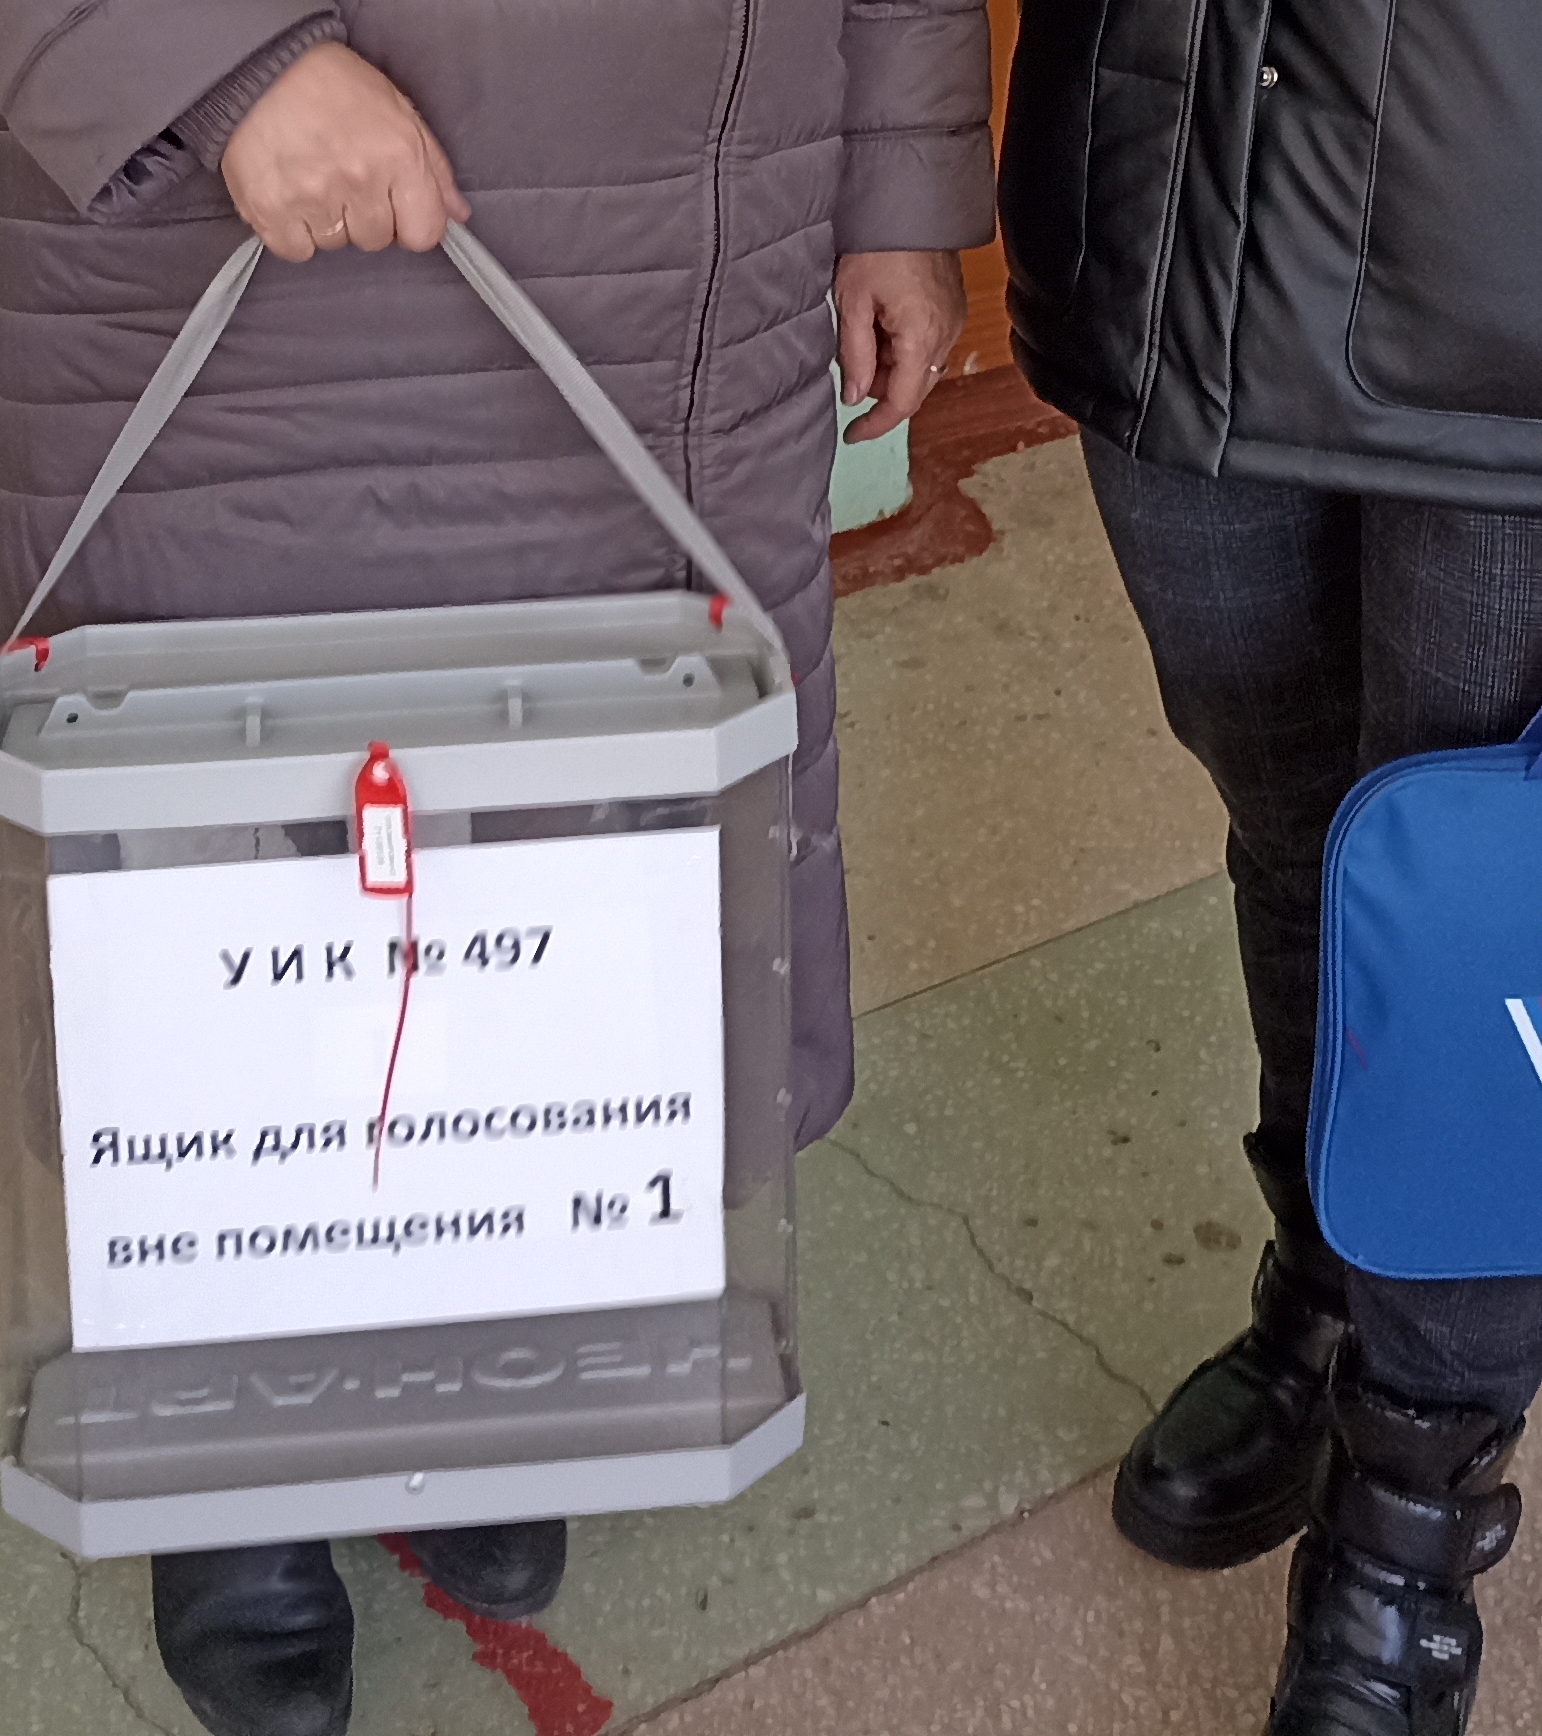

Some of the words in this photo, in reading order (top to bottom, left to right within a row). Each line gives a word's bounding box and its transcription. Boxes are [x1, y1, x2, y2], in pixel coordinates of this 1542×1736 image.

[462, 925, 554, 973] 497
[89, 1126, 236, 1172] Ящик
[251, 1117, 347, 1166] для
[365, 1091, 692, 1150] голосования
[107, 1230, 199, 1269] вне
[215, 1203, 526, 1262] помещения
[645, 1168, 684, 1226] 1
